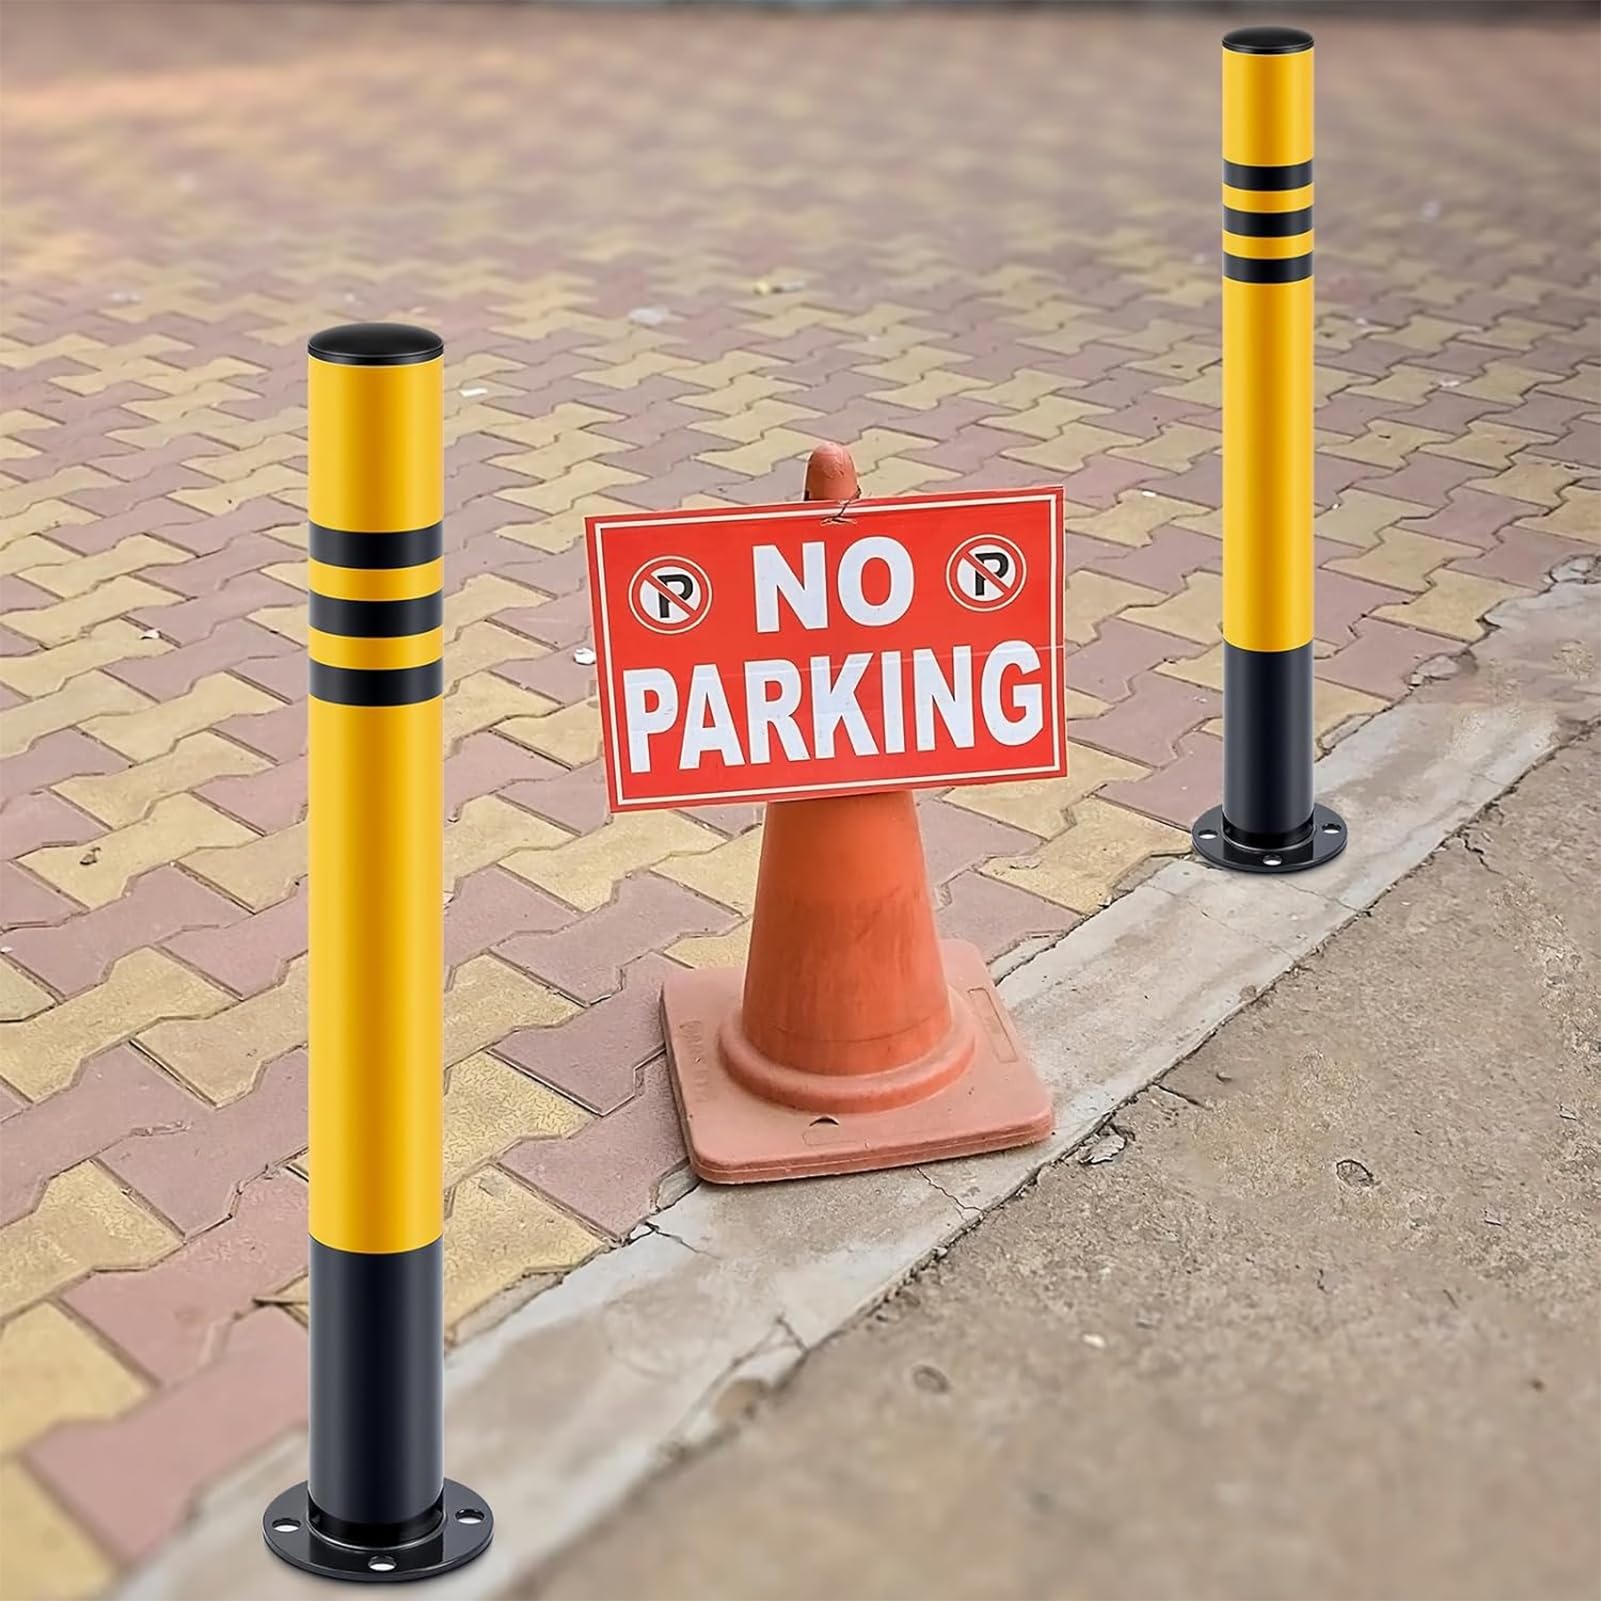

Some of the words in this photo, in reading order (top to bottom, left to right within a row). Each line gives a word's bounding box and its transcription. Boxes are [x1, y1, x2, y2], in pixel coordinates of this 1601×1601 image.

[656, 574, 695, 619] P
[752, 536, 915, 633] NO
[974, 551, 1010, 597] P
[622, 640, 1044, 774] PARKING
